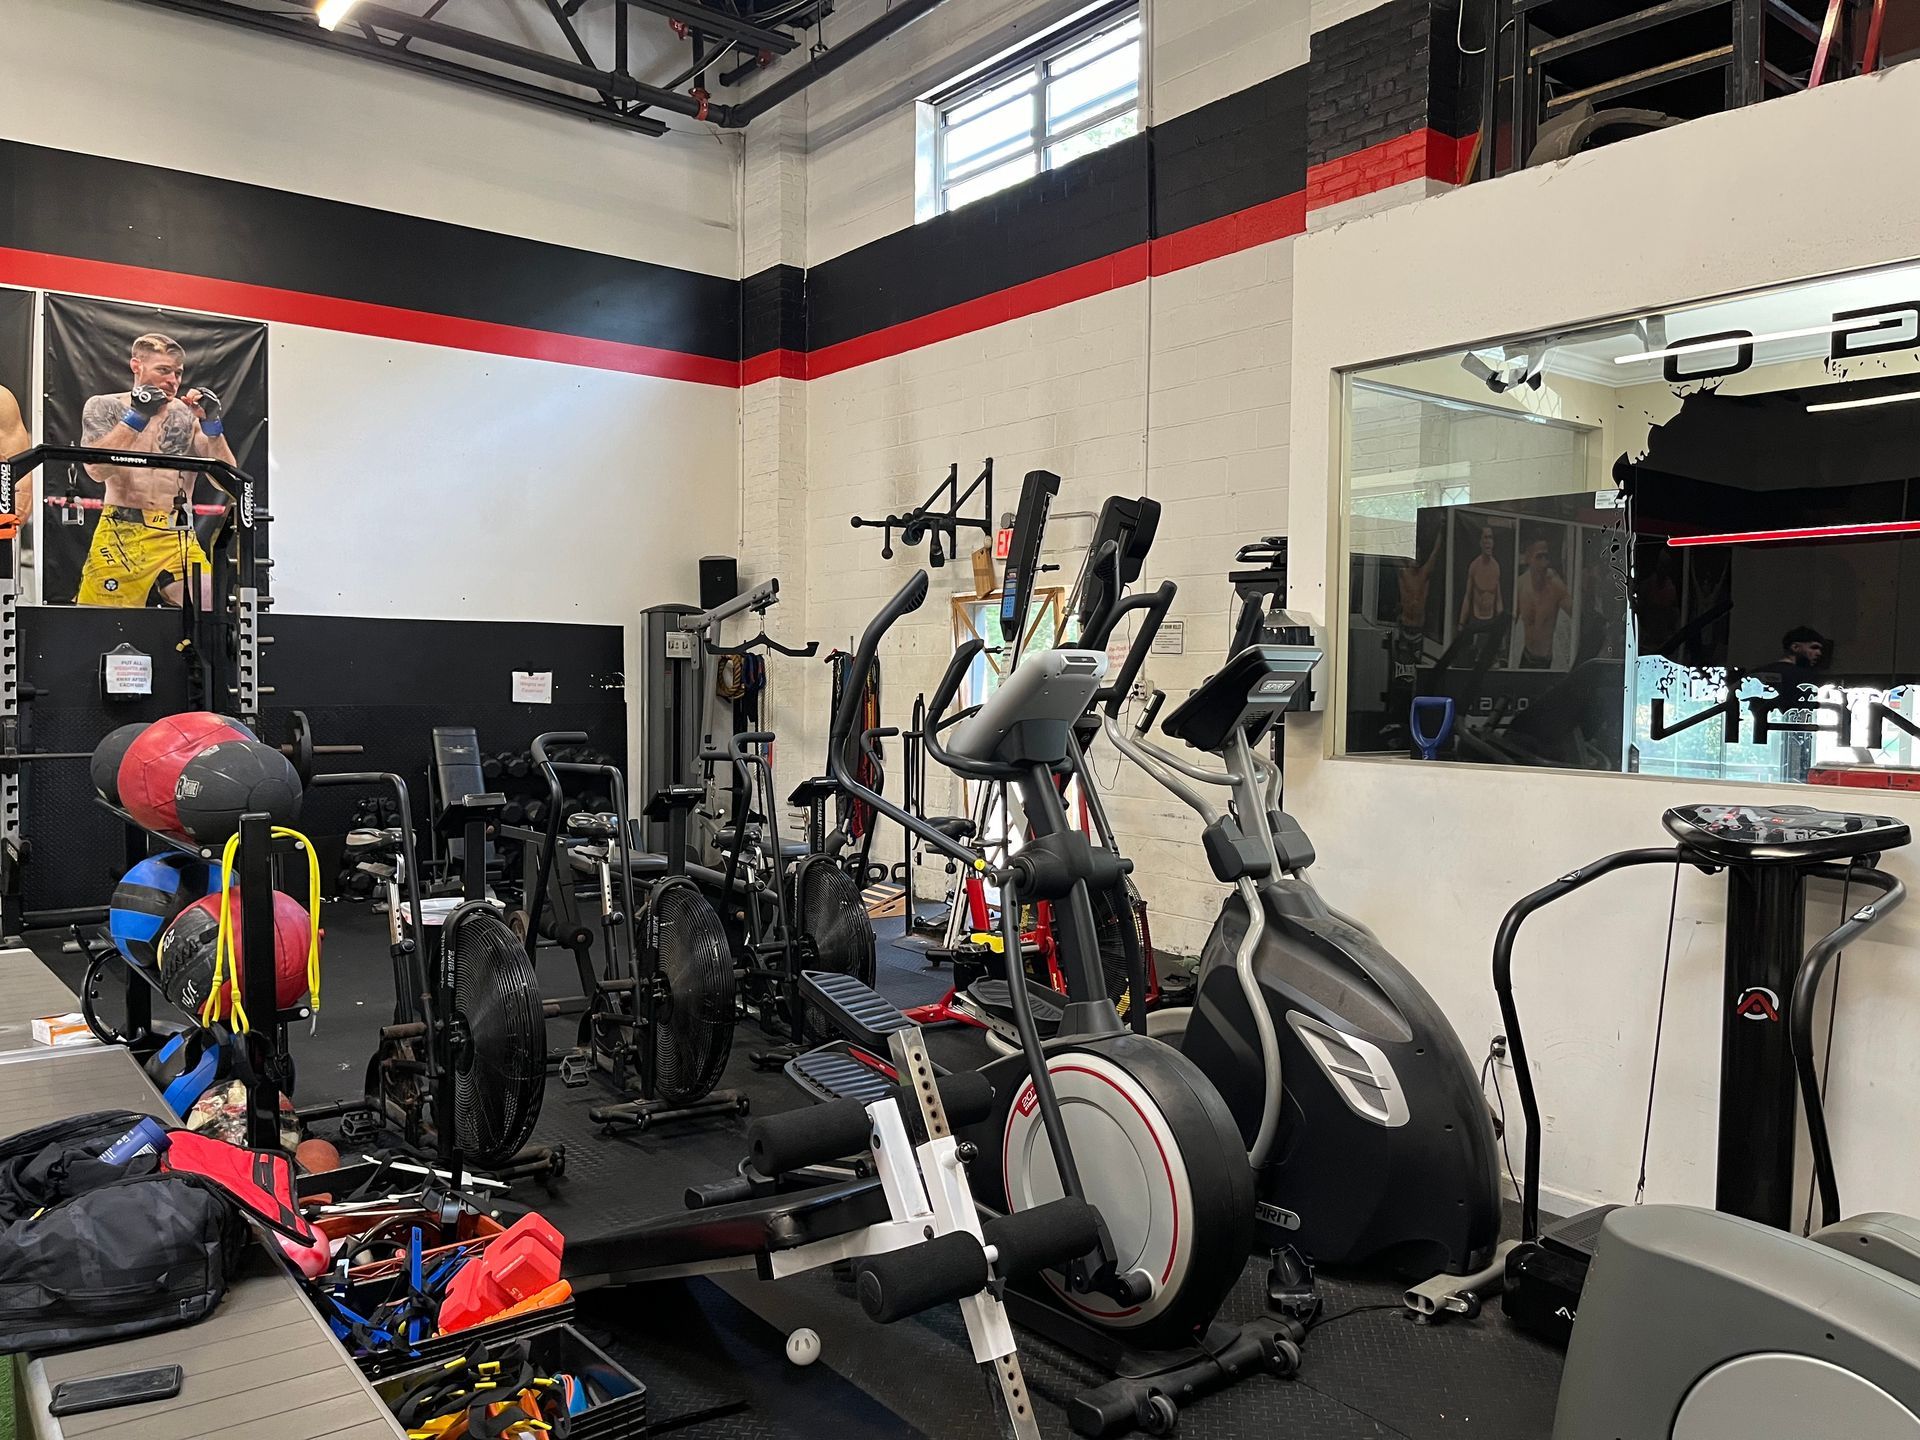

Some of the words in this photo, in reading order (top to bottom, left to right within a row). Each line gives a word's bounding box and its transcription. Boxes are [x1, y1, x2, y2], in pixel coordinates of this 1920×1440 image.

[241, 482, 253, 528] LEGEND
[100, 547, 116, 565] UFC
[1255, 1205, 1293, 1225] PIRIT
